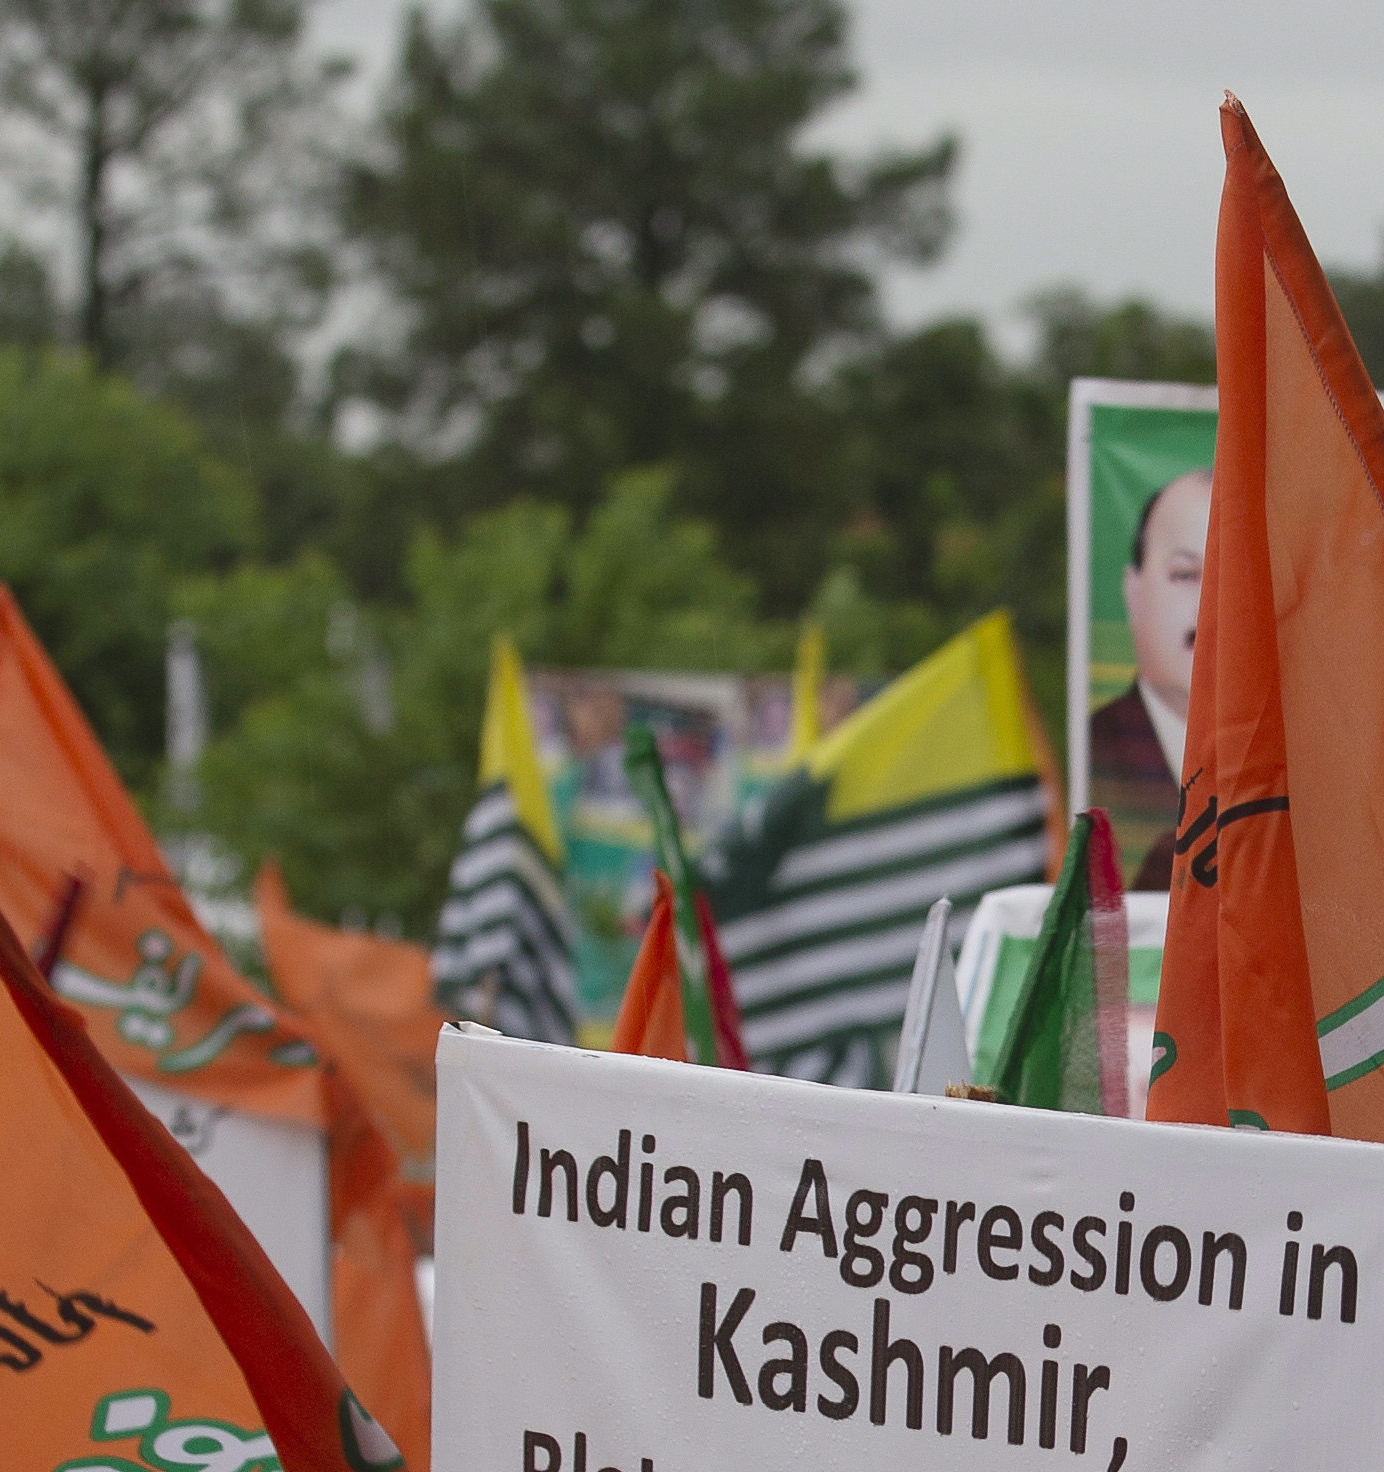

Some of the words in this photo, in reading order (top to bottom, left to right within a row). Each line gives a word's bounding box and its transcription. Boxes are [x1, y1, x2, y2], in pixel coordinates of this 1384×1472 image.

[512, 1121, 753, 1247] Indian
[779, 1158, 1247, 1311] Aggression
[1279, 1210, 1358, 1324] in
